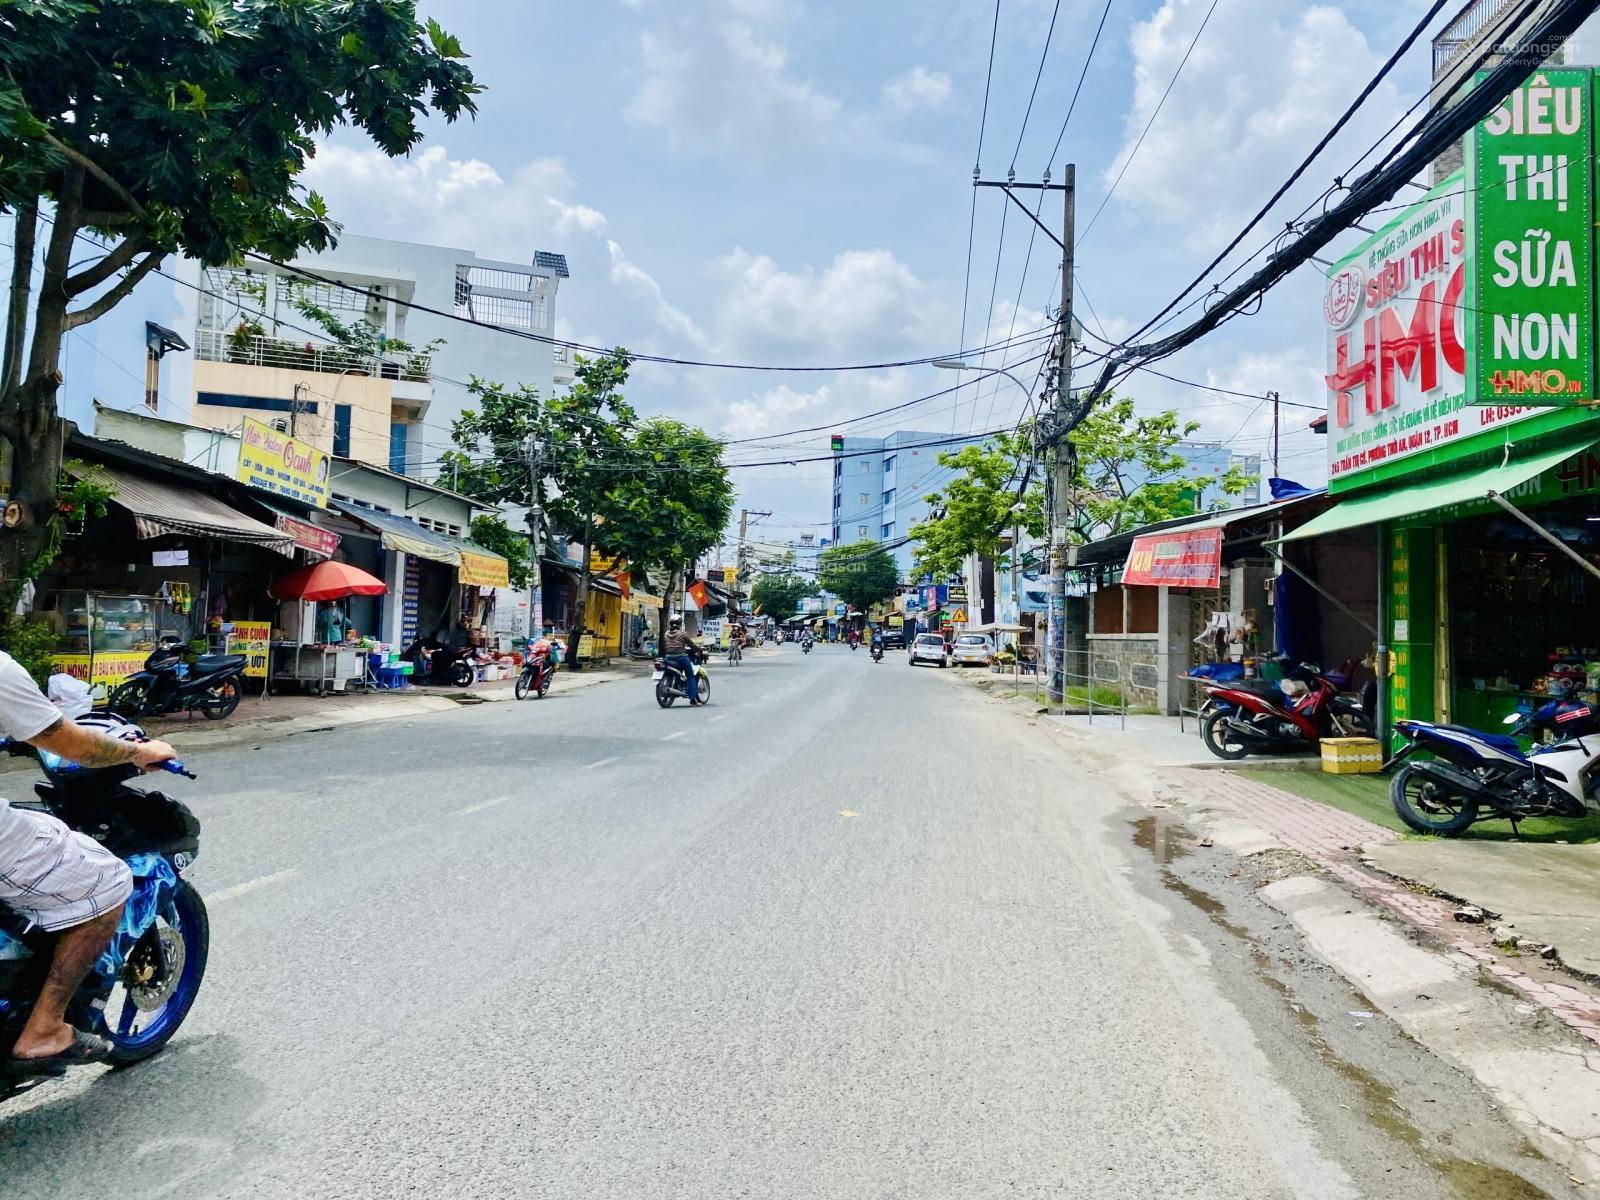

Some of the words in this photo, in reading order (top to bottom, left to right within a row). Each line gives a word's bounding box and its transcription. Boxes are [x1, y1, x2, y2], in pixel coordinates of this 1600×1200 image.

[1485, 74, 1581, 135] SIÊU
[1498, 155, 1567, 212] THỊ
[1376, 238, 1396, 262] THỐNG
[1492, 228, 1577, 288] SỮA
[1366, 257, 1406, 308] SIÊU
[1410, 231, 1445, 281] THỊ
[1493, 312, 1578, 361] NON
[1444, 419, 1459, 437] HCM
[1480, 407, 1495, 426] LH:
[283, 440, 314, 476] Oanh
[249, 625, 269, 641] CUỐN
[67, 660, 88, 679] NÓNG
